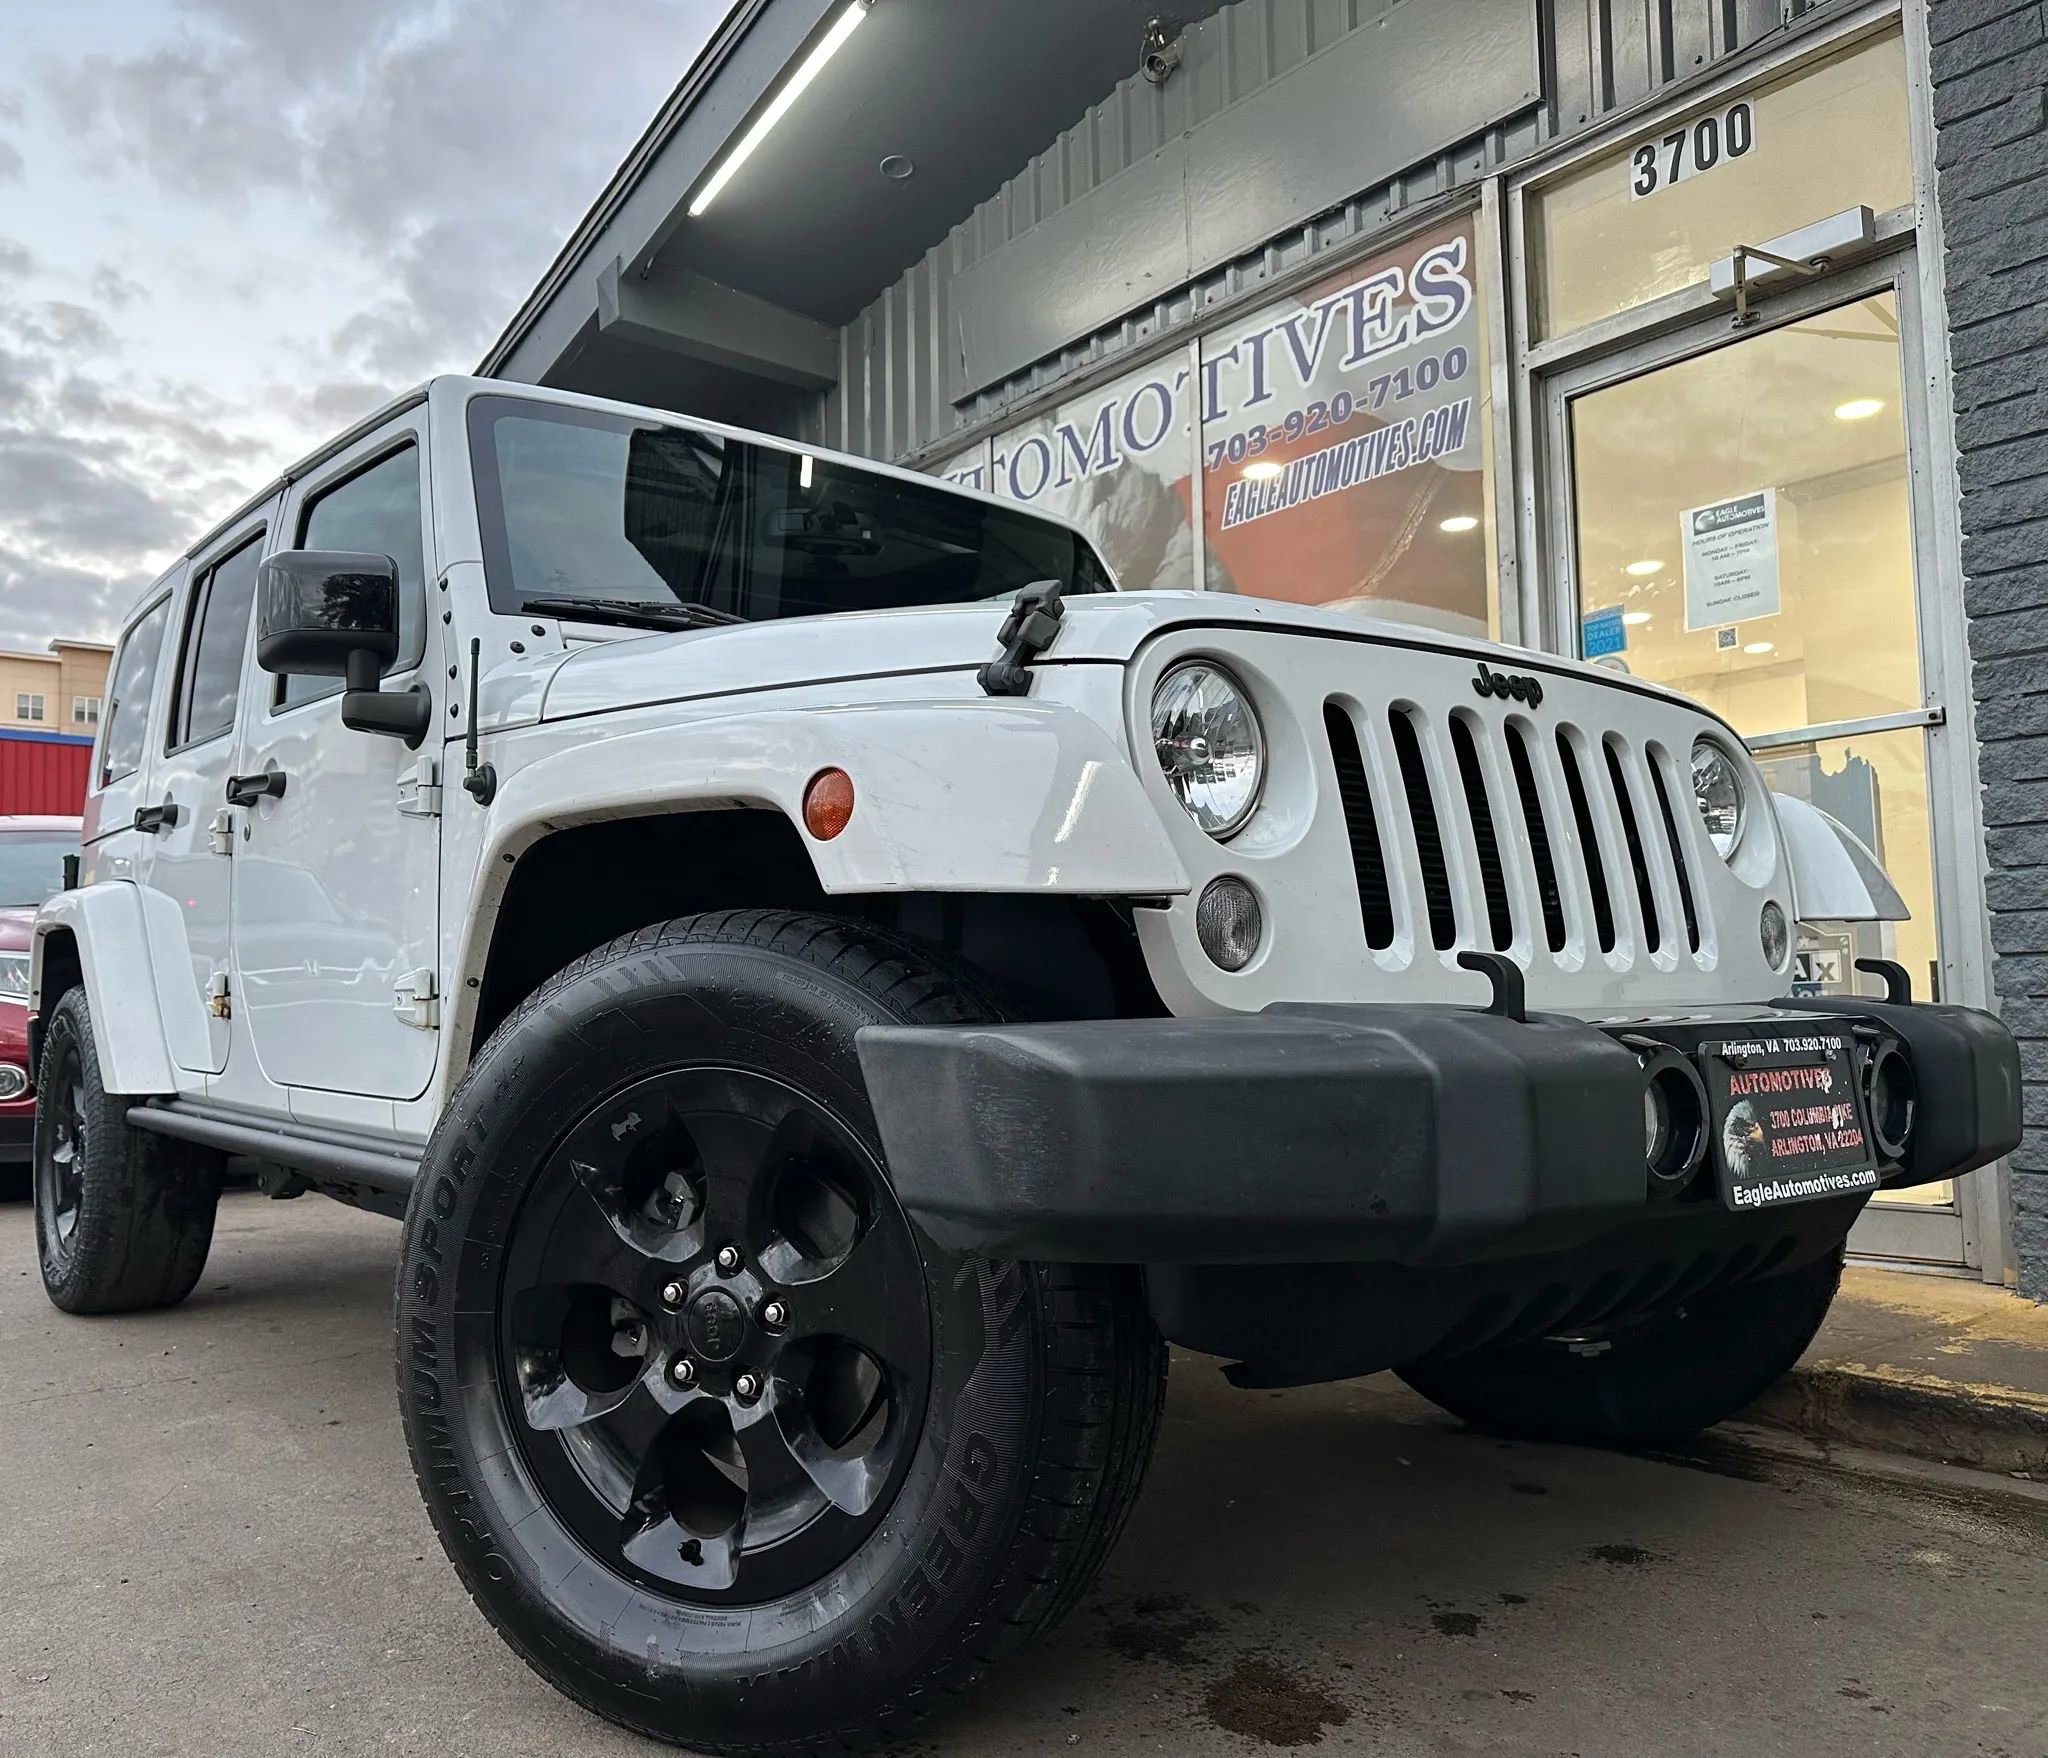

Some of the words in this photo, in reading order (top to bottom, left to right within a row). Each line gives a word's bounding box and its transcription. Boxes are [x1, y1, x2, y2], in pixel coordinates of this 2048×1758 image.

[1634, 103, 1751, 196] 3700
[934, 240, 1470, 500] TOMOTIVES
[1209, 346, 1468, 472] 703-920-7100
[1221, 398, 1472, 530] EAGLEAUTOMOTIVES.COM
[1715, 505, 1738, 518] EAGLE
[1716, 505, 1765, 524] AUTOMOTIVES
[1692, 535, 1716, 546] HOURS
[1717, 532, 1728, 541] OF
[1728, 522, 1769, 538] OPERATION
[1702, 546, 1728, 557] MONDAY
[1733, 590, 1760, 601] CLOSED
[1587, 627, 1621, 641] DEALER
[1588, 636, 1622, 655] 2021
[1472, 662, 1543, 710] Jeep
[1722, 1040, 1765, 1057] Arlington,
[1765, 1042, 1780, 1053] VA
[1784, 1037, 1842, 1052] 703.920.7100
[1769, 1110, 1790, 1130] 3700
[1790, 1106, 1833, 1127] COLUMBIA
[1771, 1134, 1826, 1157] ARLINGTON,
[1825, 1132, 1839, 1150] VA
[1733, 1169, 1877, 1208] EagleAutomotives.com
[413, 1103, 488, 1300] SPORT
[411, 1314, 514, 1582] OPTIMUM
